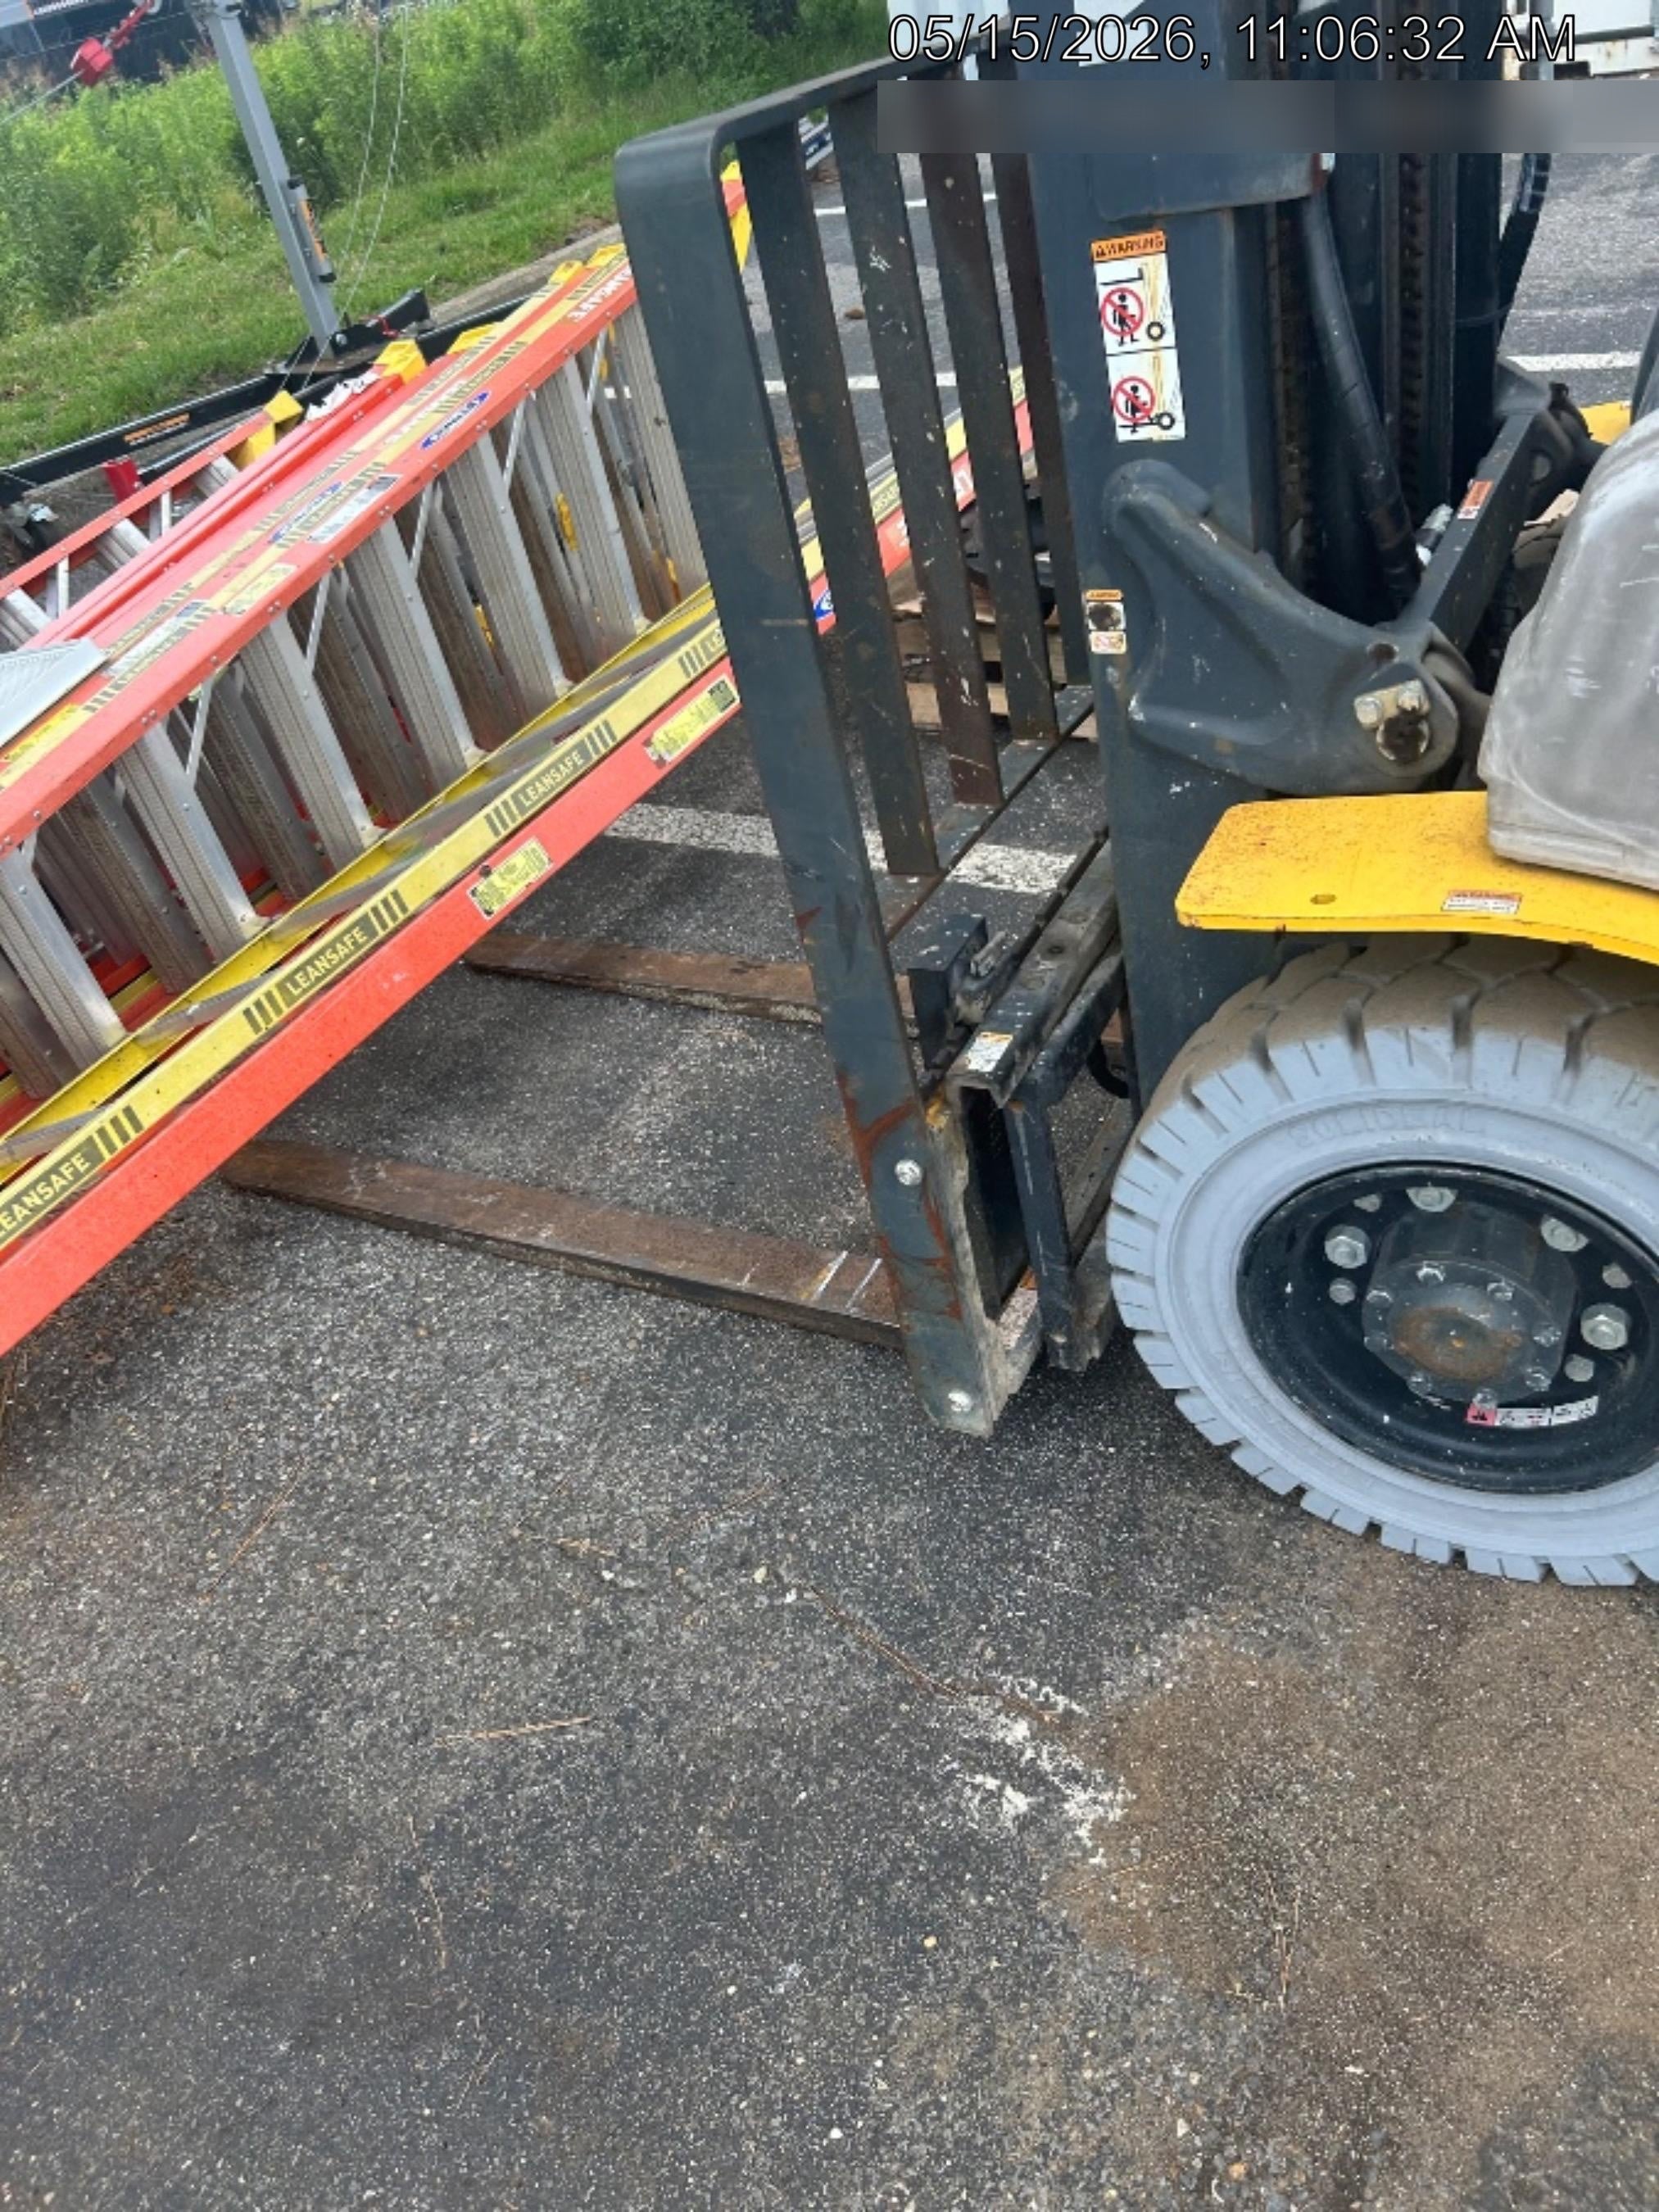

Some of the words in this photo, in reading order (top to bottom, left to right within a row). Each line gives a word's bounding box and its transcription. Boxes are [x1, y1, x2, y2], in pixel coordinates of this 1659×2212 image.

[1106, 234, 1164, 255] WARNING
[518, 749, 584, 807] LEANSAFE
[286, 926, 367, 996] LEANSAFE
[0, 1152, 92, 1237] EANSAFE
